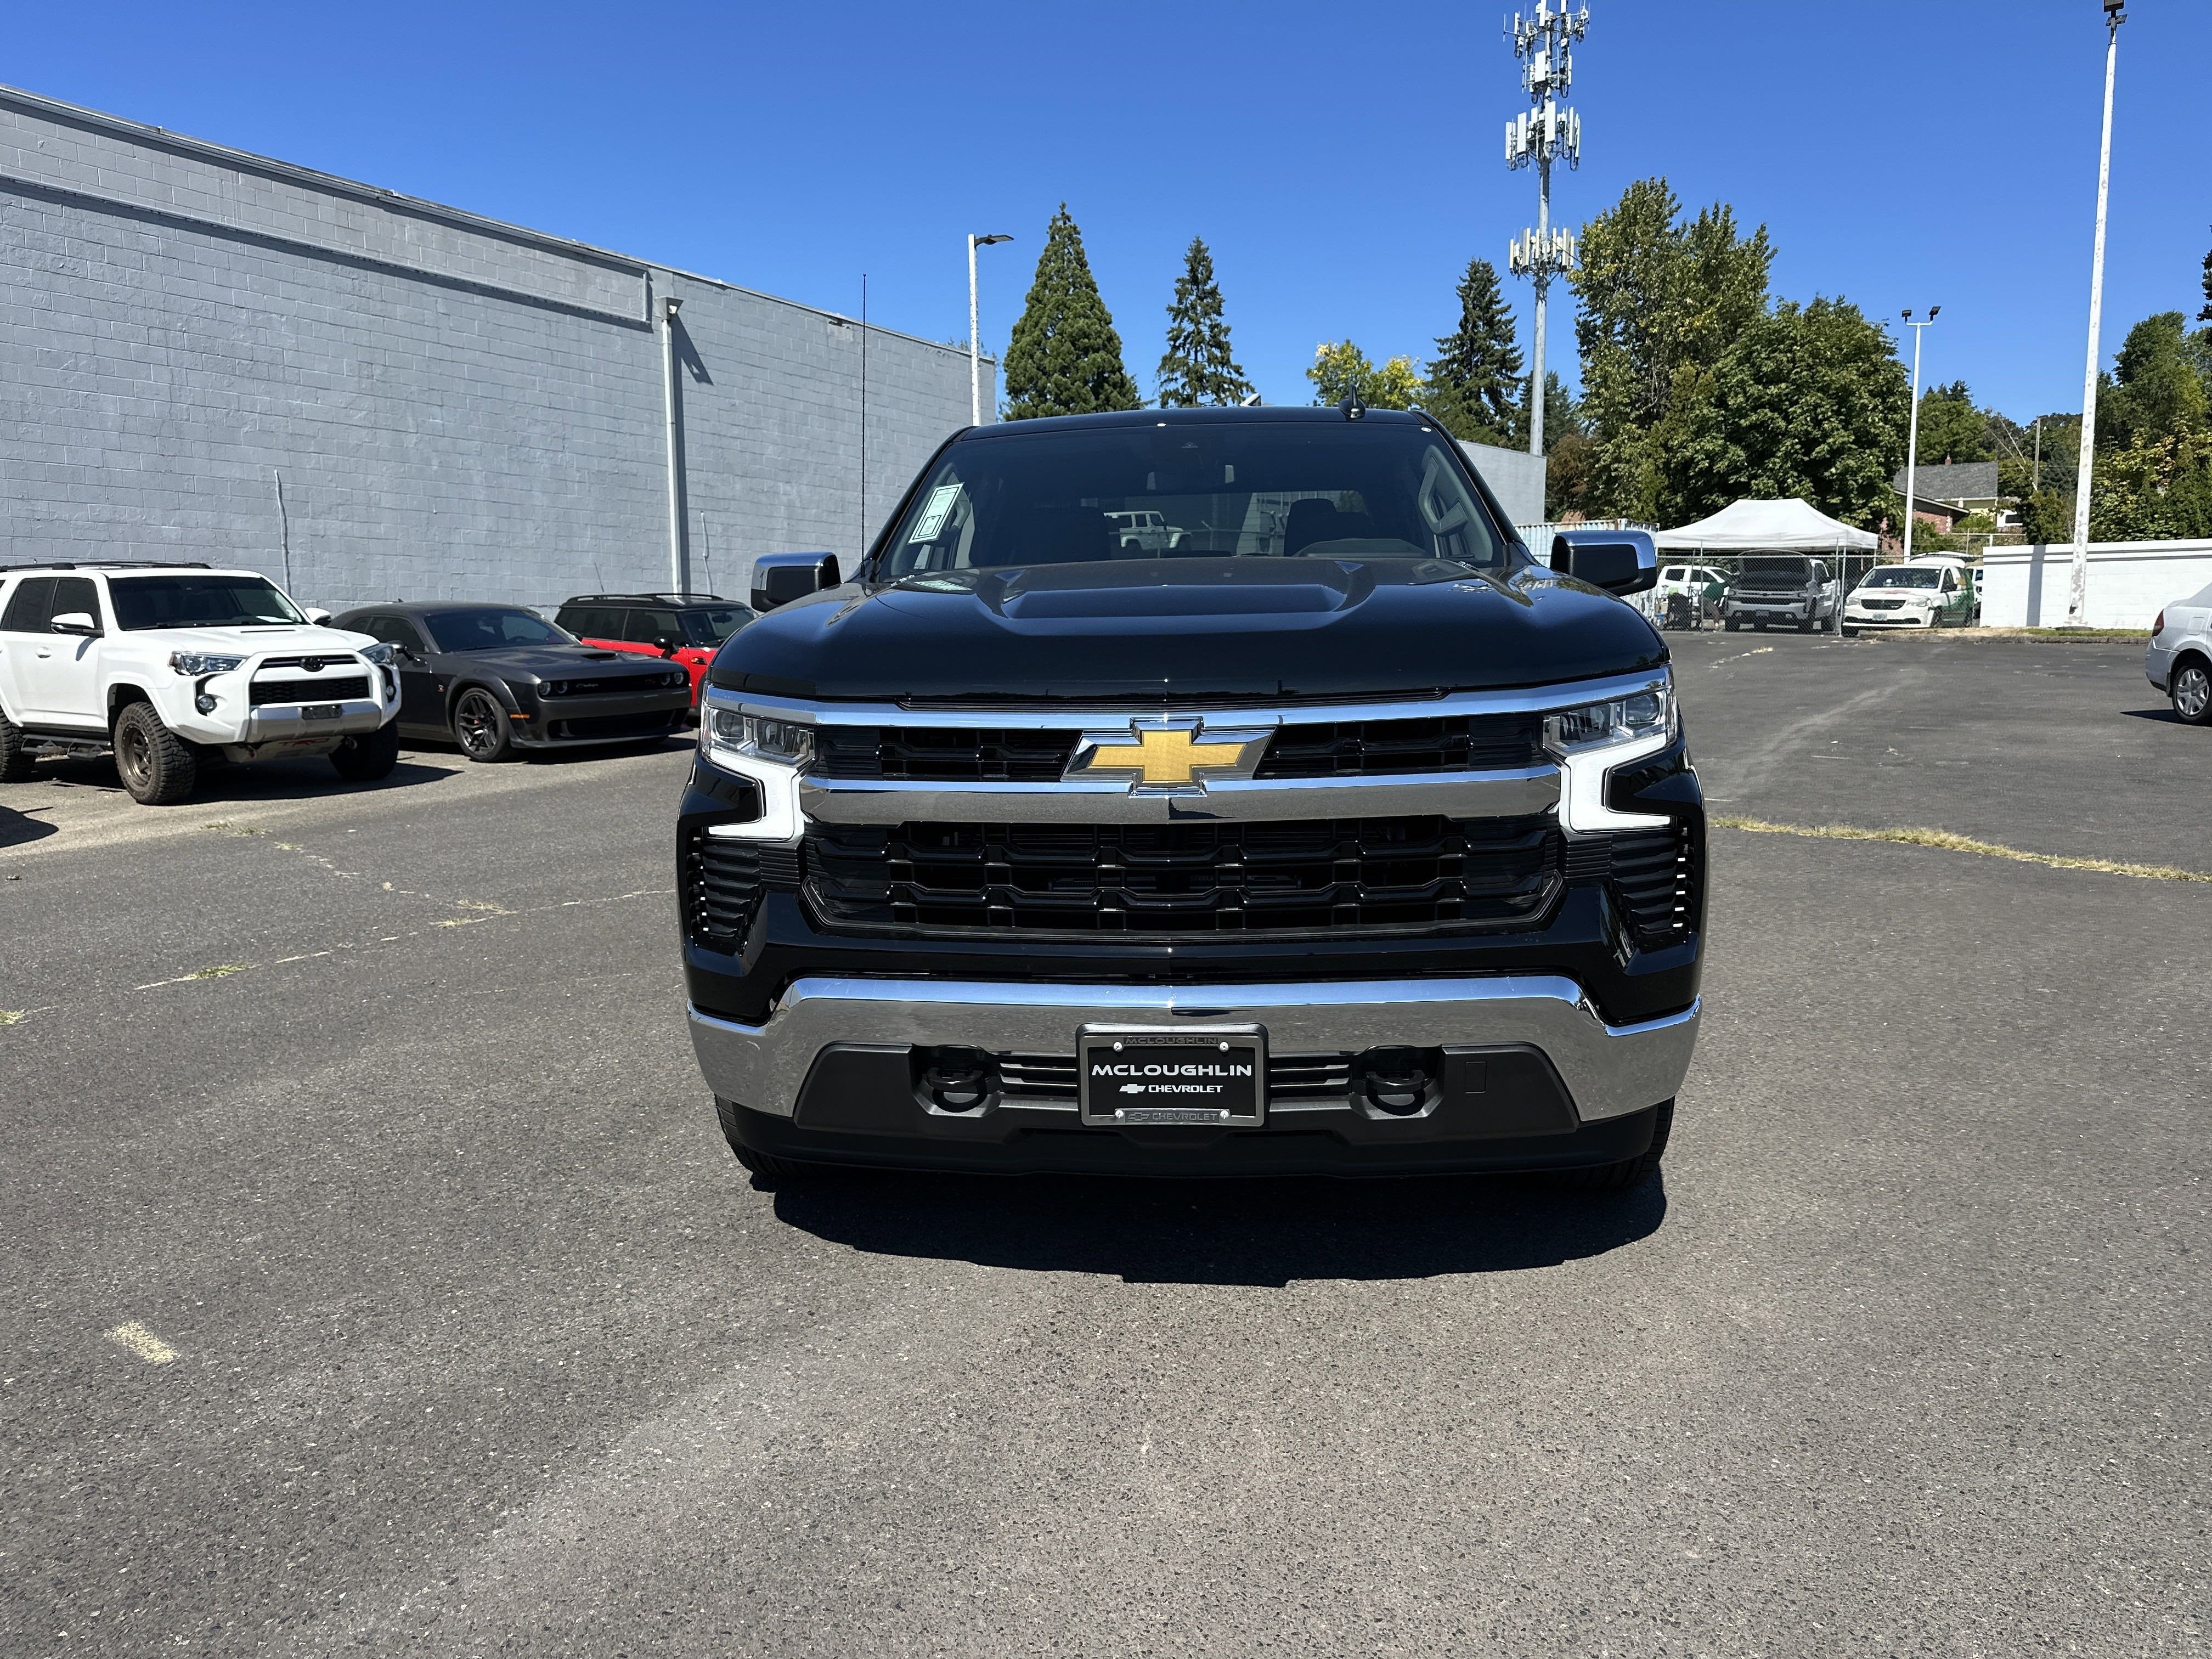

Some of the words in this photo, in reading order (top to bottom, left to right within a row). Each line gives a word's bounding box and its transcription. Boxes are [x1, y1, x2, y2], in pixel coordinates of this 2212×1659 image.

[1092, 1064, 1251, 1076] MCLOUGHLIN
[1148, 1085, 1223, 1093] CHEVROLET
[1152, 1113, 1217, 1121] CHEVROLET
